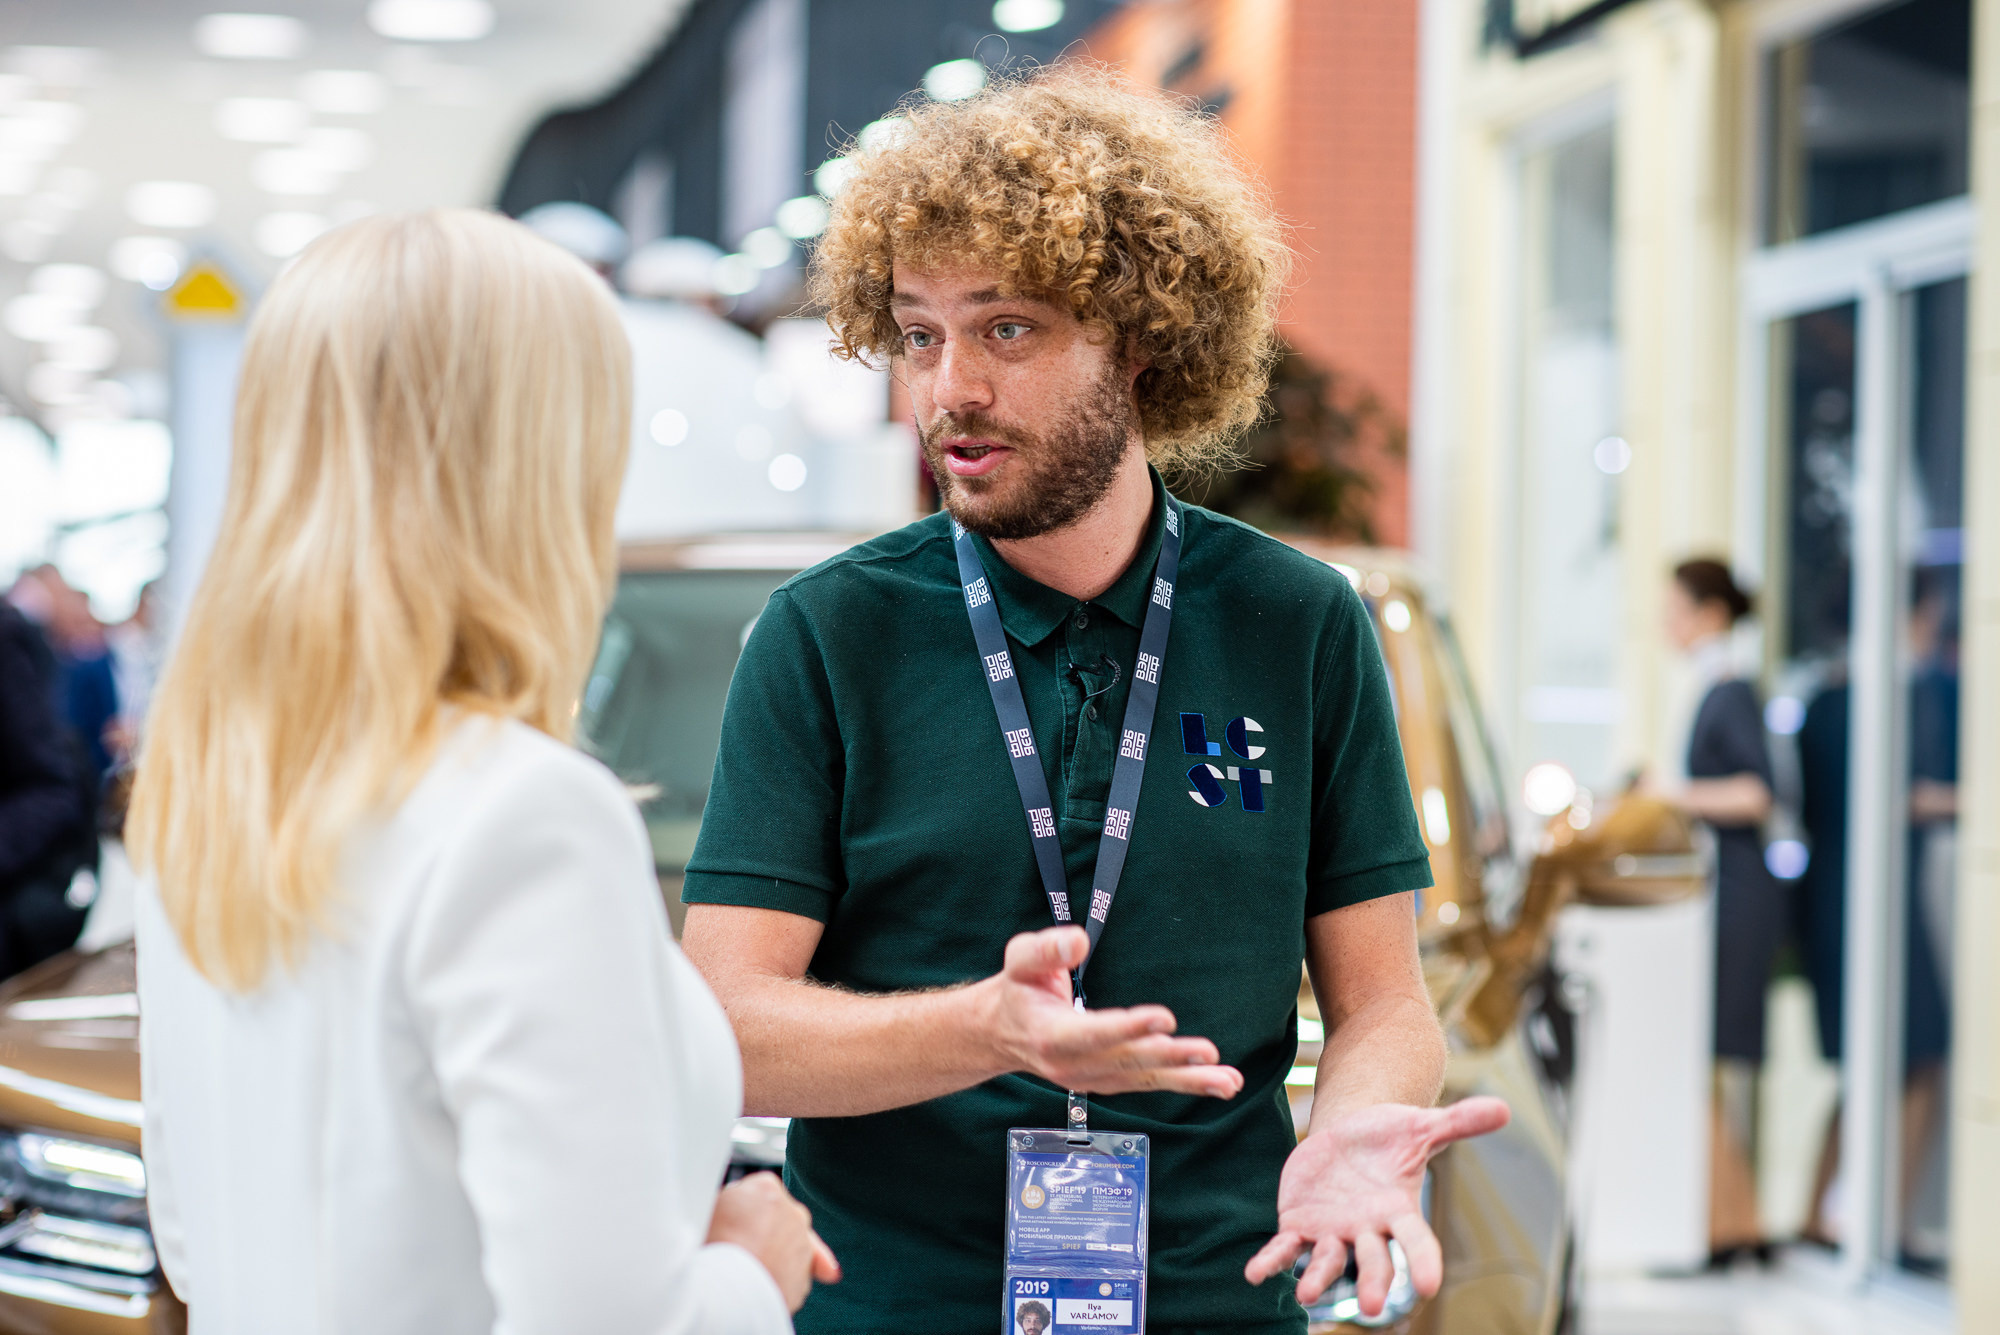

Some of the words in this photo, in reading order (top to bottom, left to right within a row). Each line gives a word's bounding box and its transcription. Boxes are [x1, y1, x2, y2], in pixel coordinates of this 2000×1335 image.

[1049, 1185, 1087, 1194] SPIEF'19
[1092, 1187, 1133, 1196] ПМЭФ'19
[1015, 1281, 1049, 1294] 2019
[1087, 1303, 1102, 1311] Ilya
[1070, 1312, 1119, 1320] VARLAMOV
